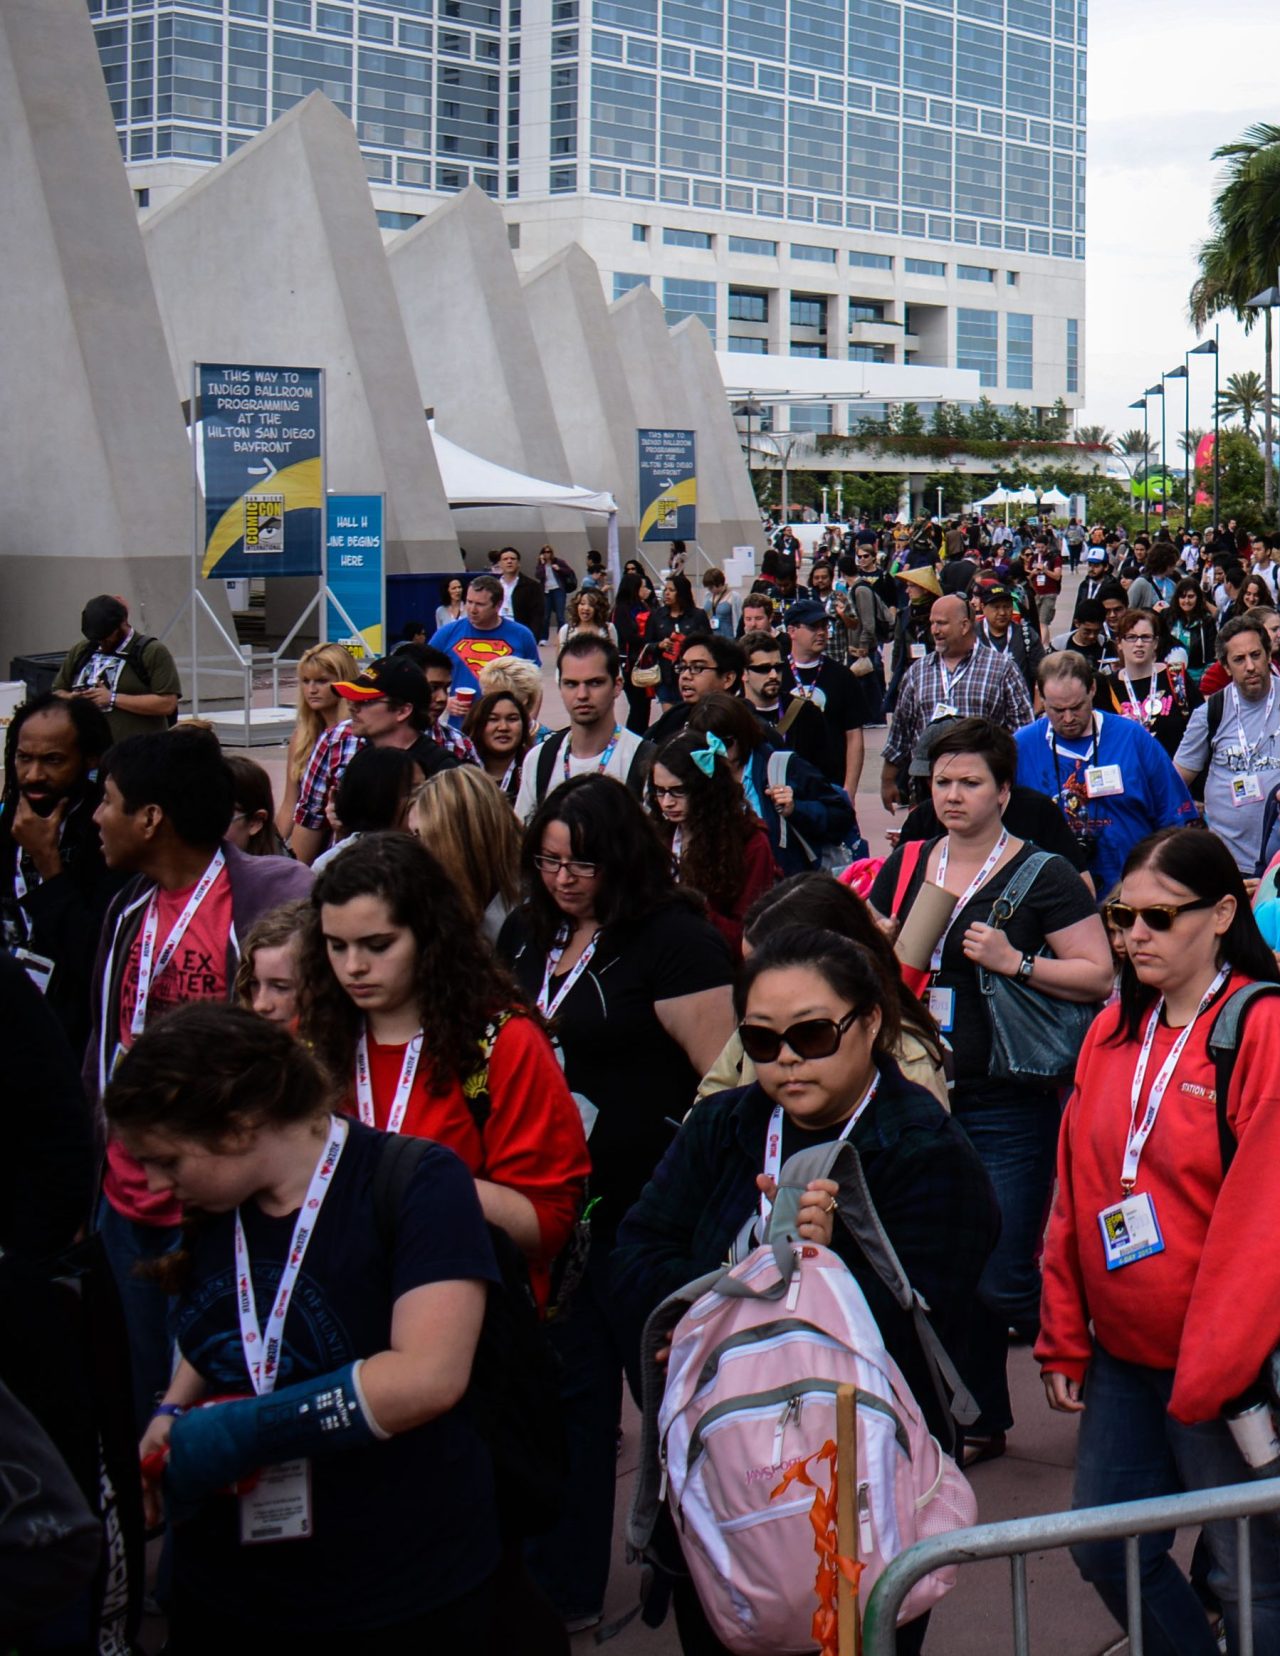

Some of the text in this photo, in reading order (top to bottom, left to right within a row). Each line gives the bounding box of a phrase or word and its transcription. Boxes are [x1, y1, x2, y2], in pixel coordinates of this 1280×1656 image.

[222, 369, 300, 383] THIS WAY TO
[207, 383, 313, 398] INDIGO BALLROOM
[217, 397, 300, 411] PROGRAMMING
[238, 413, 282, 425] AT THE
[207, 425, 316, 440] HILTON SAN DIEGO
[233, 441, 292, 453] BAYFRONT
[259, 502, 281, 517] CON
[246, 502, 259, 545] COMIC
[336, 516, 368, 528] HALL H
[347, 535, 380, 548] BEGINS
[340, 555, 364, 567] HERE
